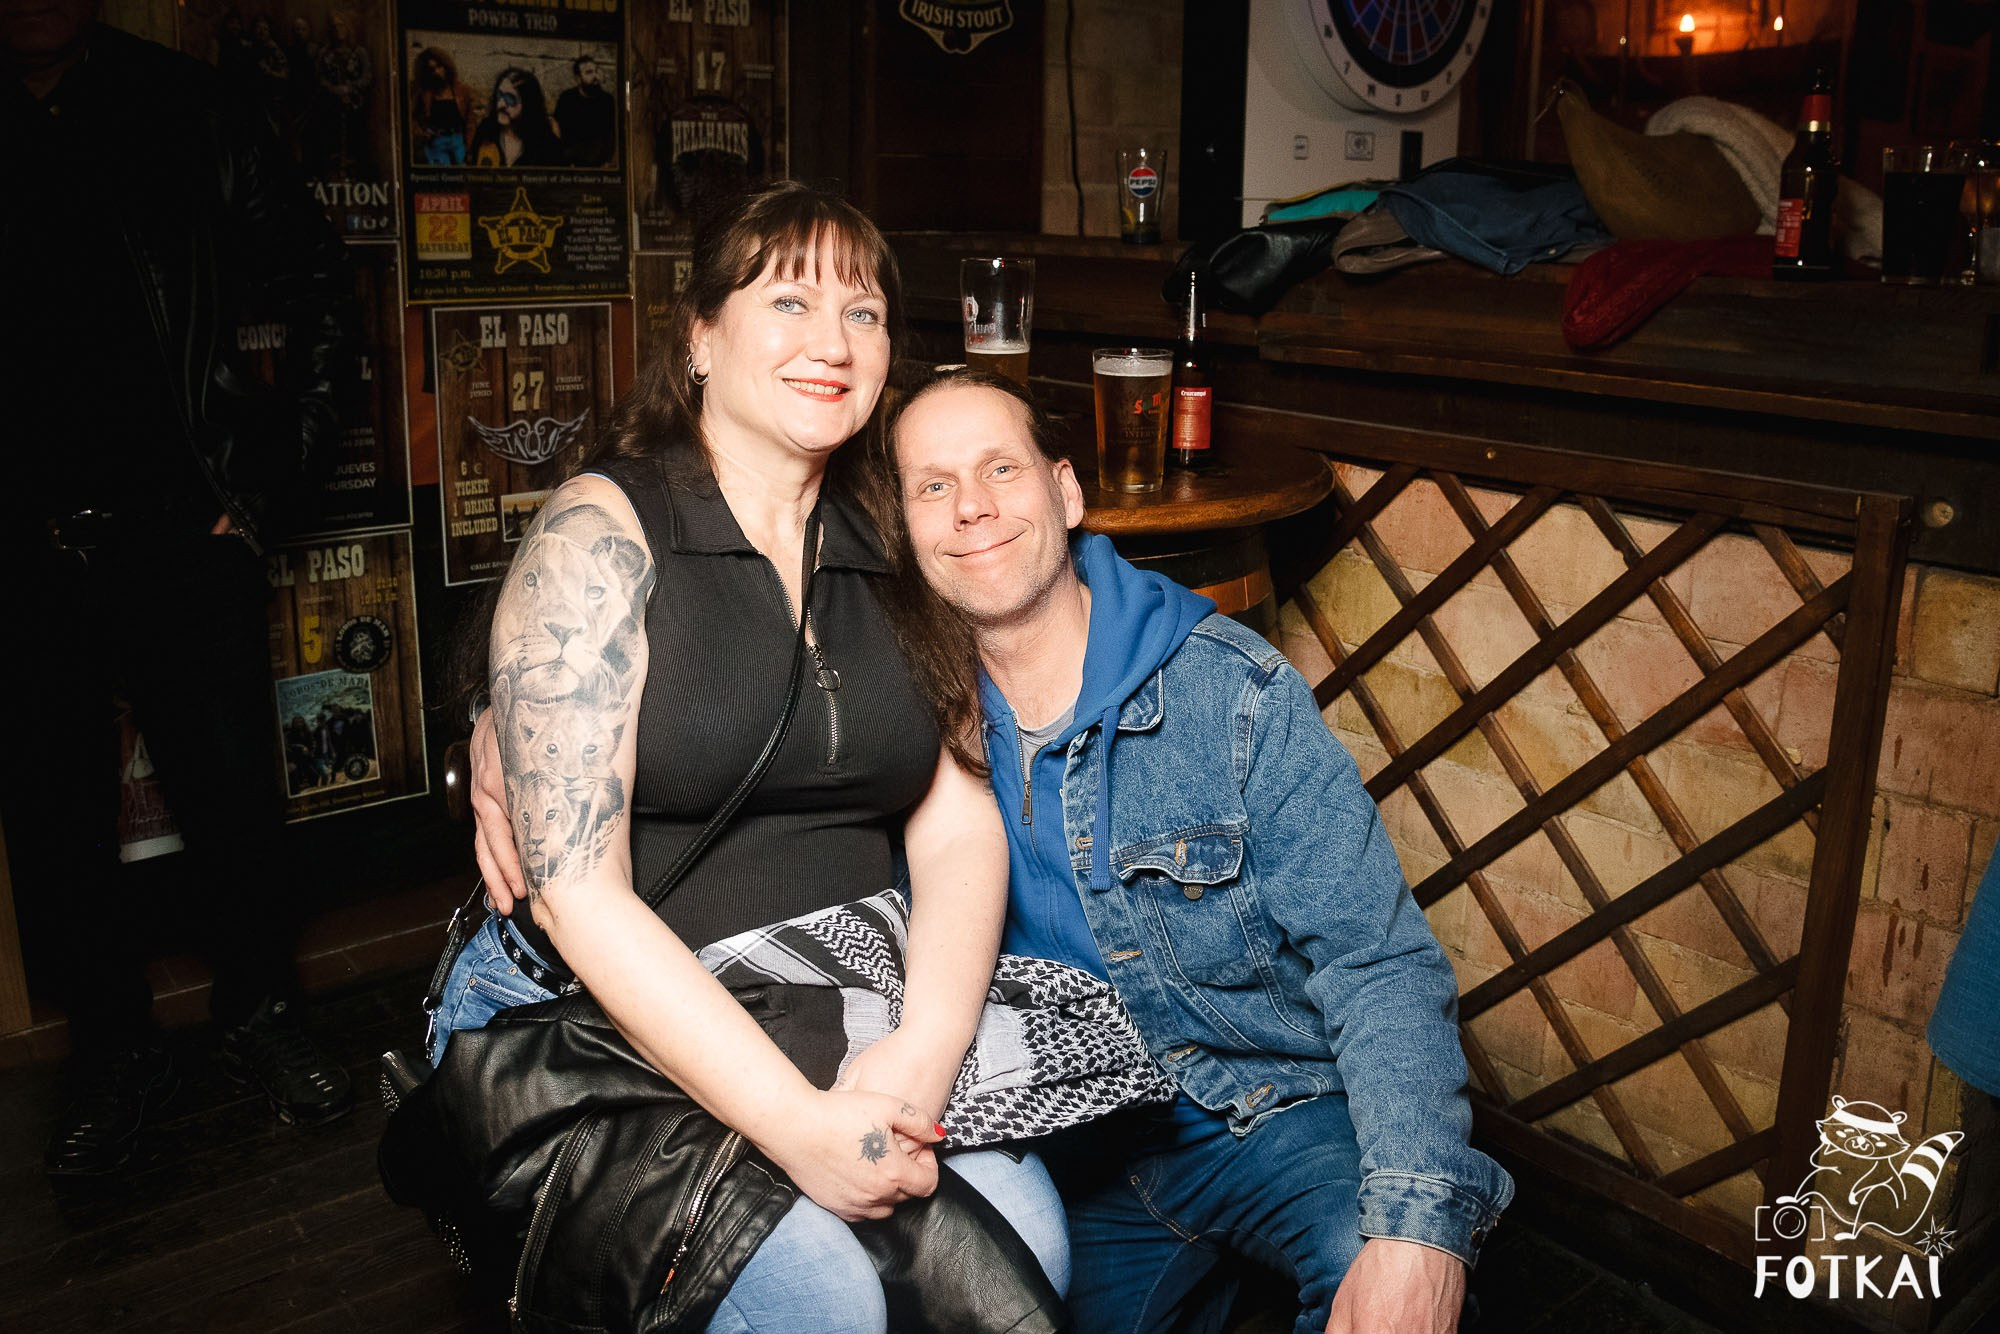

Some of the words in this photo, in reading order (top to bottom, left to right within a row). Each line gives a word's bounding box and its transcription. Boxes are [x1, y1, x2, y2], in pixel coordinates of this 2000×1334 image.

[468, 8, 519, 29] POWER
[525, 14, 557, 31] TRIO
[668, 0, 693, 23] EL
[703, 0, 750, 27] PASO
[911, 0, 955, 27] IRISH
[956, 7, 1002, 28] STOUT
[696, 50, 726, 90] 17
[672, 120, 749, 163] HELLHATES
[306, 178, 390, 207] ATION
[1130, 178, 1156, 186] PEPSI
[421, 195, 465, 211] APRIL
[428, 215, 457, 242] 22
[498, 227, 513, 244] EL
[519, 226, 546, 244] PASO
[418, 242, 469, 253] SATURDAY
[479, 315, 507, 348] EL
[517, 312, 569, 347] PASO
[512, 370, 545, 412] 27
[335, 462, 376, 475] JUEVES
[455, 479, 490, 497] TICKET
[464, 497, 496, 516] DRINK
[450, 517, 498, 538] INCLUDED
[267, 553, 295, 588] EL
[307, 544, 365, 583] PASO
[303, 615, 322, 664] 5
